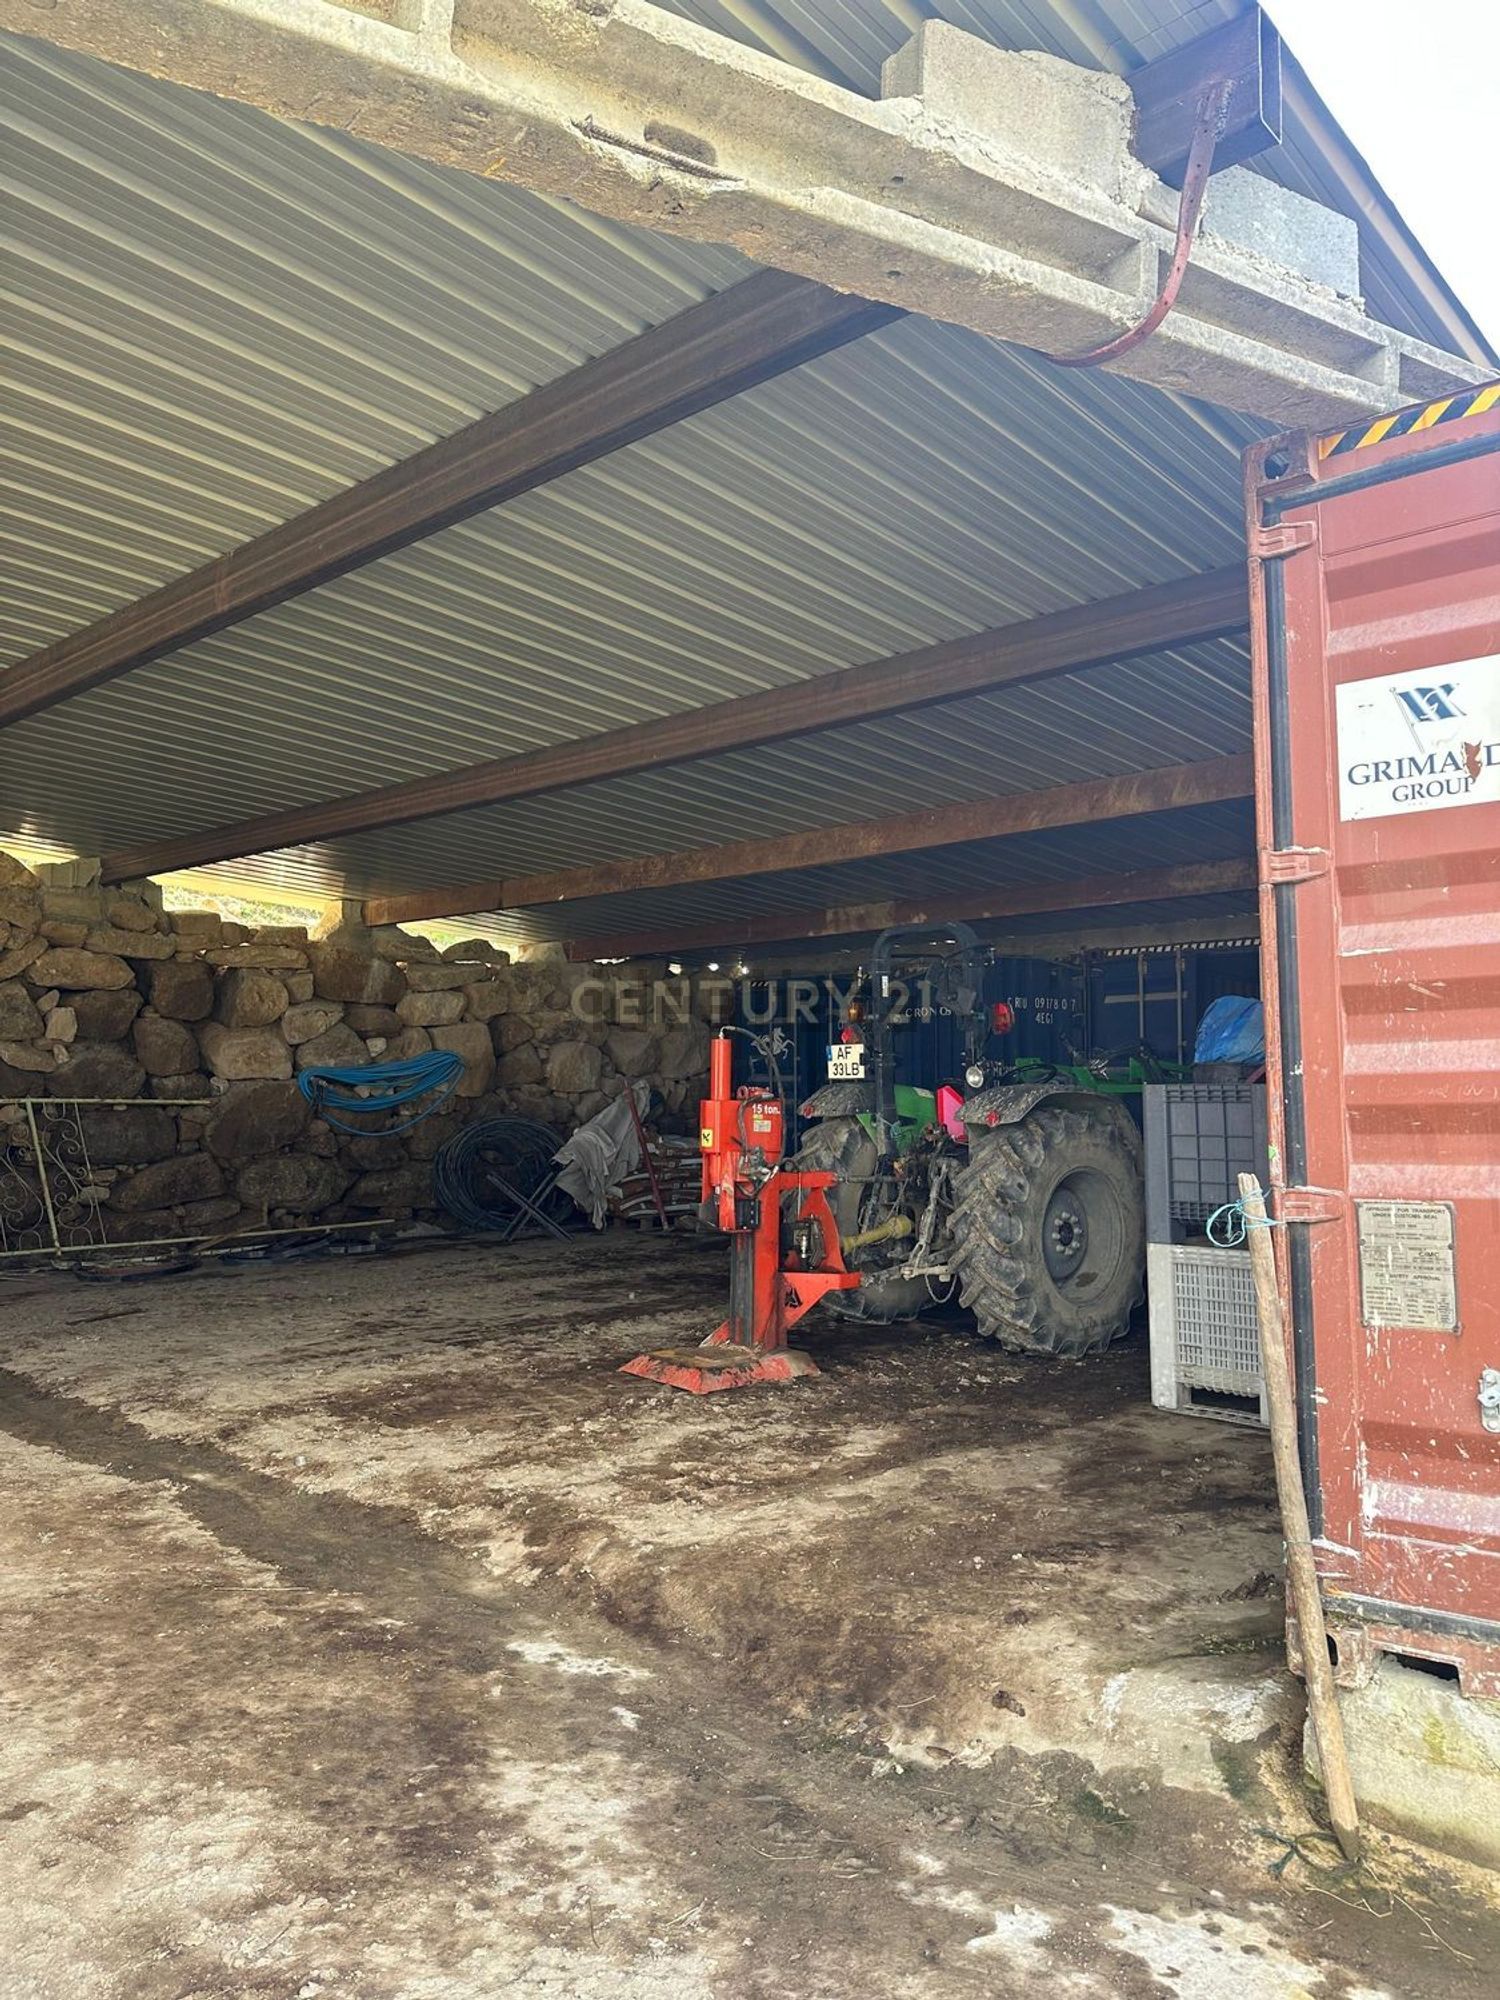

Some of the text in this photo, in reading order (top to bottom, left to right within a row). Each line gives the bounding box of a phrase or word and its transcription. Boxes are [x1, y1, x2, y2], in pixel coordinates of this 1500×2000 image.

[1347, 743, 1500, 786] GRIMAD
[1392, 775, 1476, 802] GROUP
[837, 1046, 852, 1060] AF
[832, 1062, 860, 1076] 33LB
[752, 1103, 763, 1114] 15
